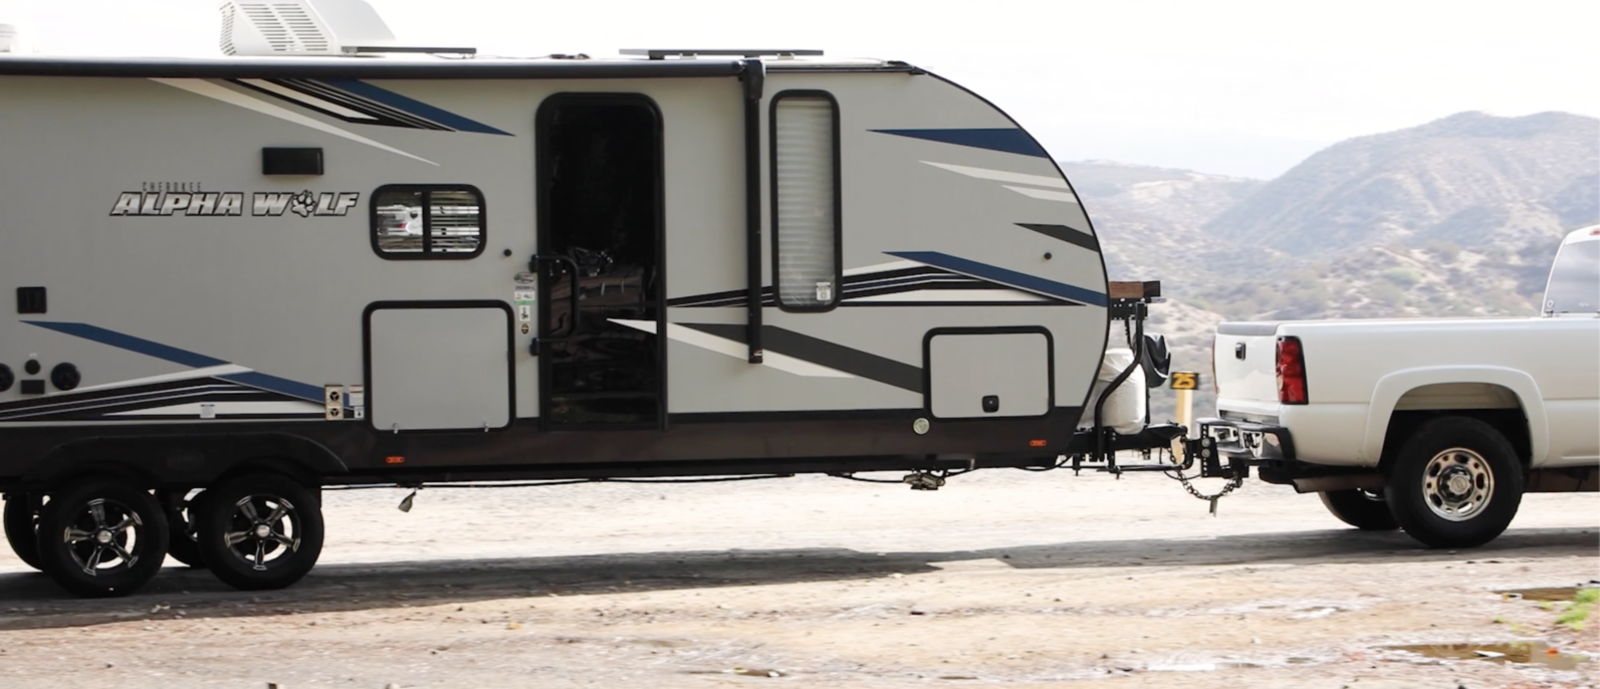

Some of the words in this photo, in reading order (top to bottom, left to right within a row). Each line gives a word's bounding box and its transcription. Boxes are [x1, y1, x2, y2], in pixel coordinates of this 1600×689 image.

[142, 181, 202, 192] CHEROKEE
[109, 192, 244, 216] ALPHA
[1171, 373, 1196, 389] 25
